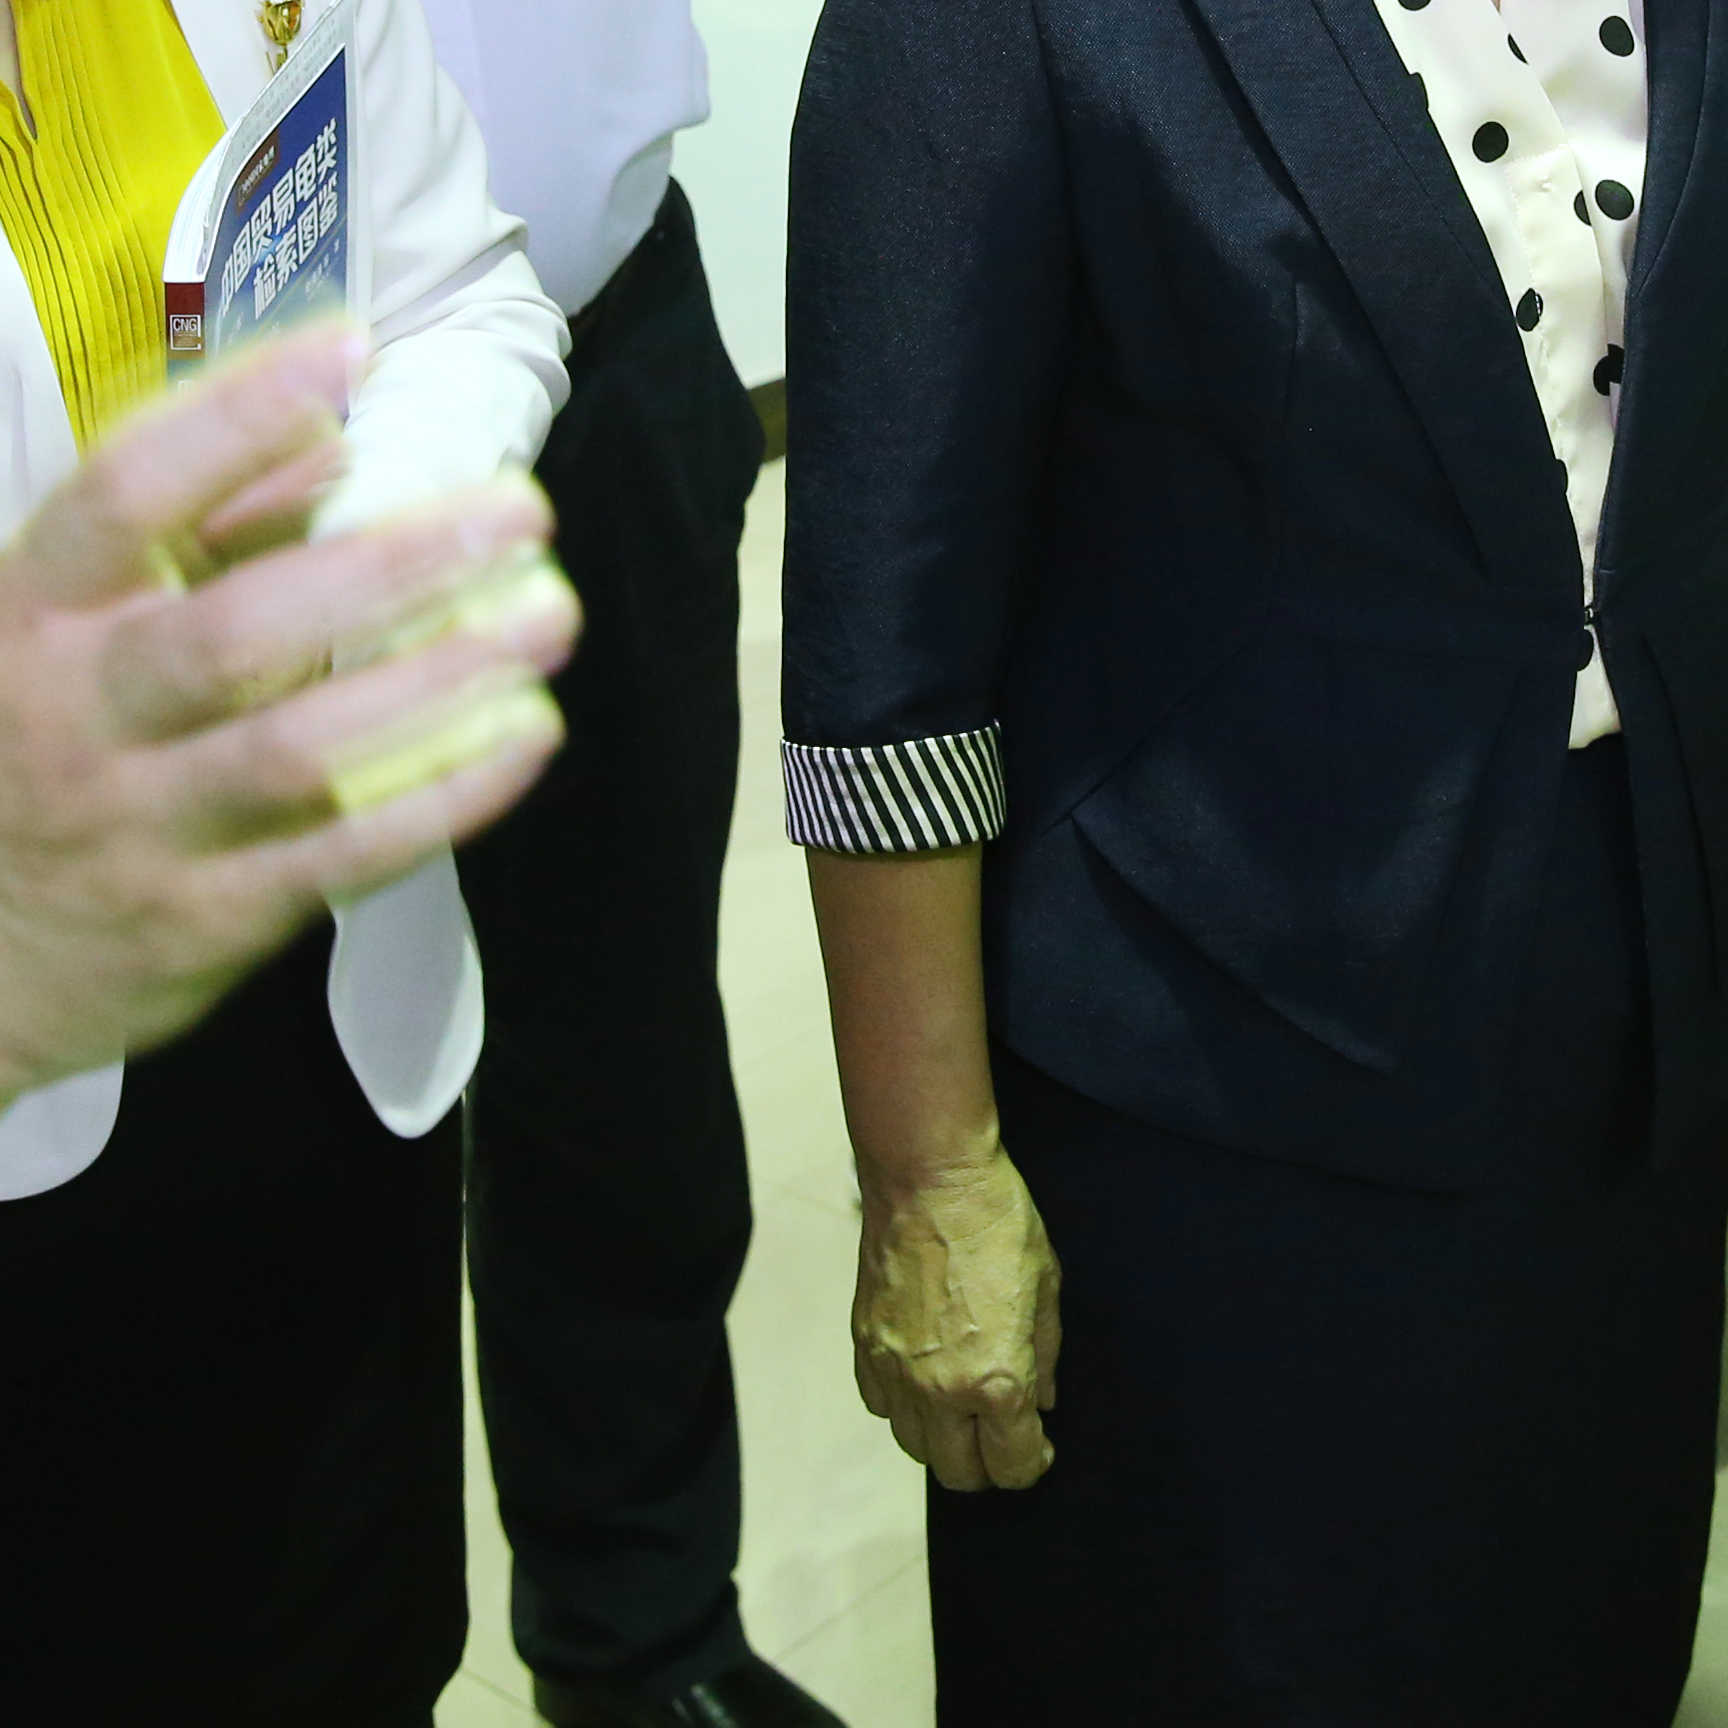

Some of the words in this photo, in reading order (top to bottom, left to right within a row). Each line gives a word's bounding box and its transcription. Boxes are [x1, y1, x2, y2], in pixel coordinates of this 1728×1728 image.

[220, 117, 338, 318] 中国贸易龟类
[253, 171, 339, 321] 检索图鉴
[173, 318, 197, 332] CNG
